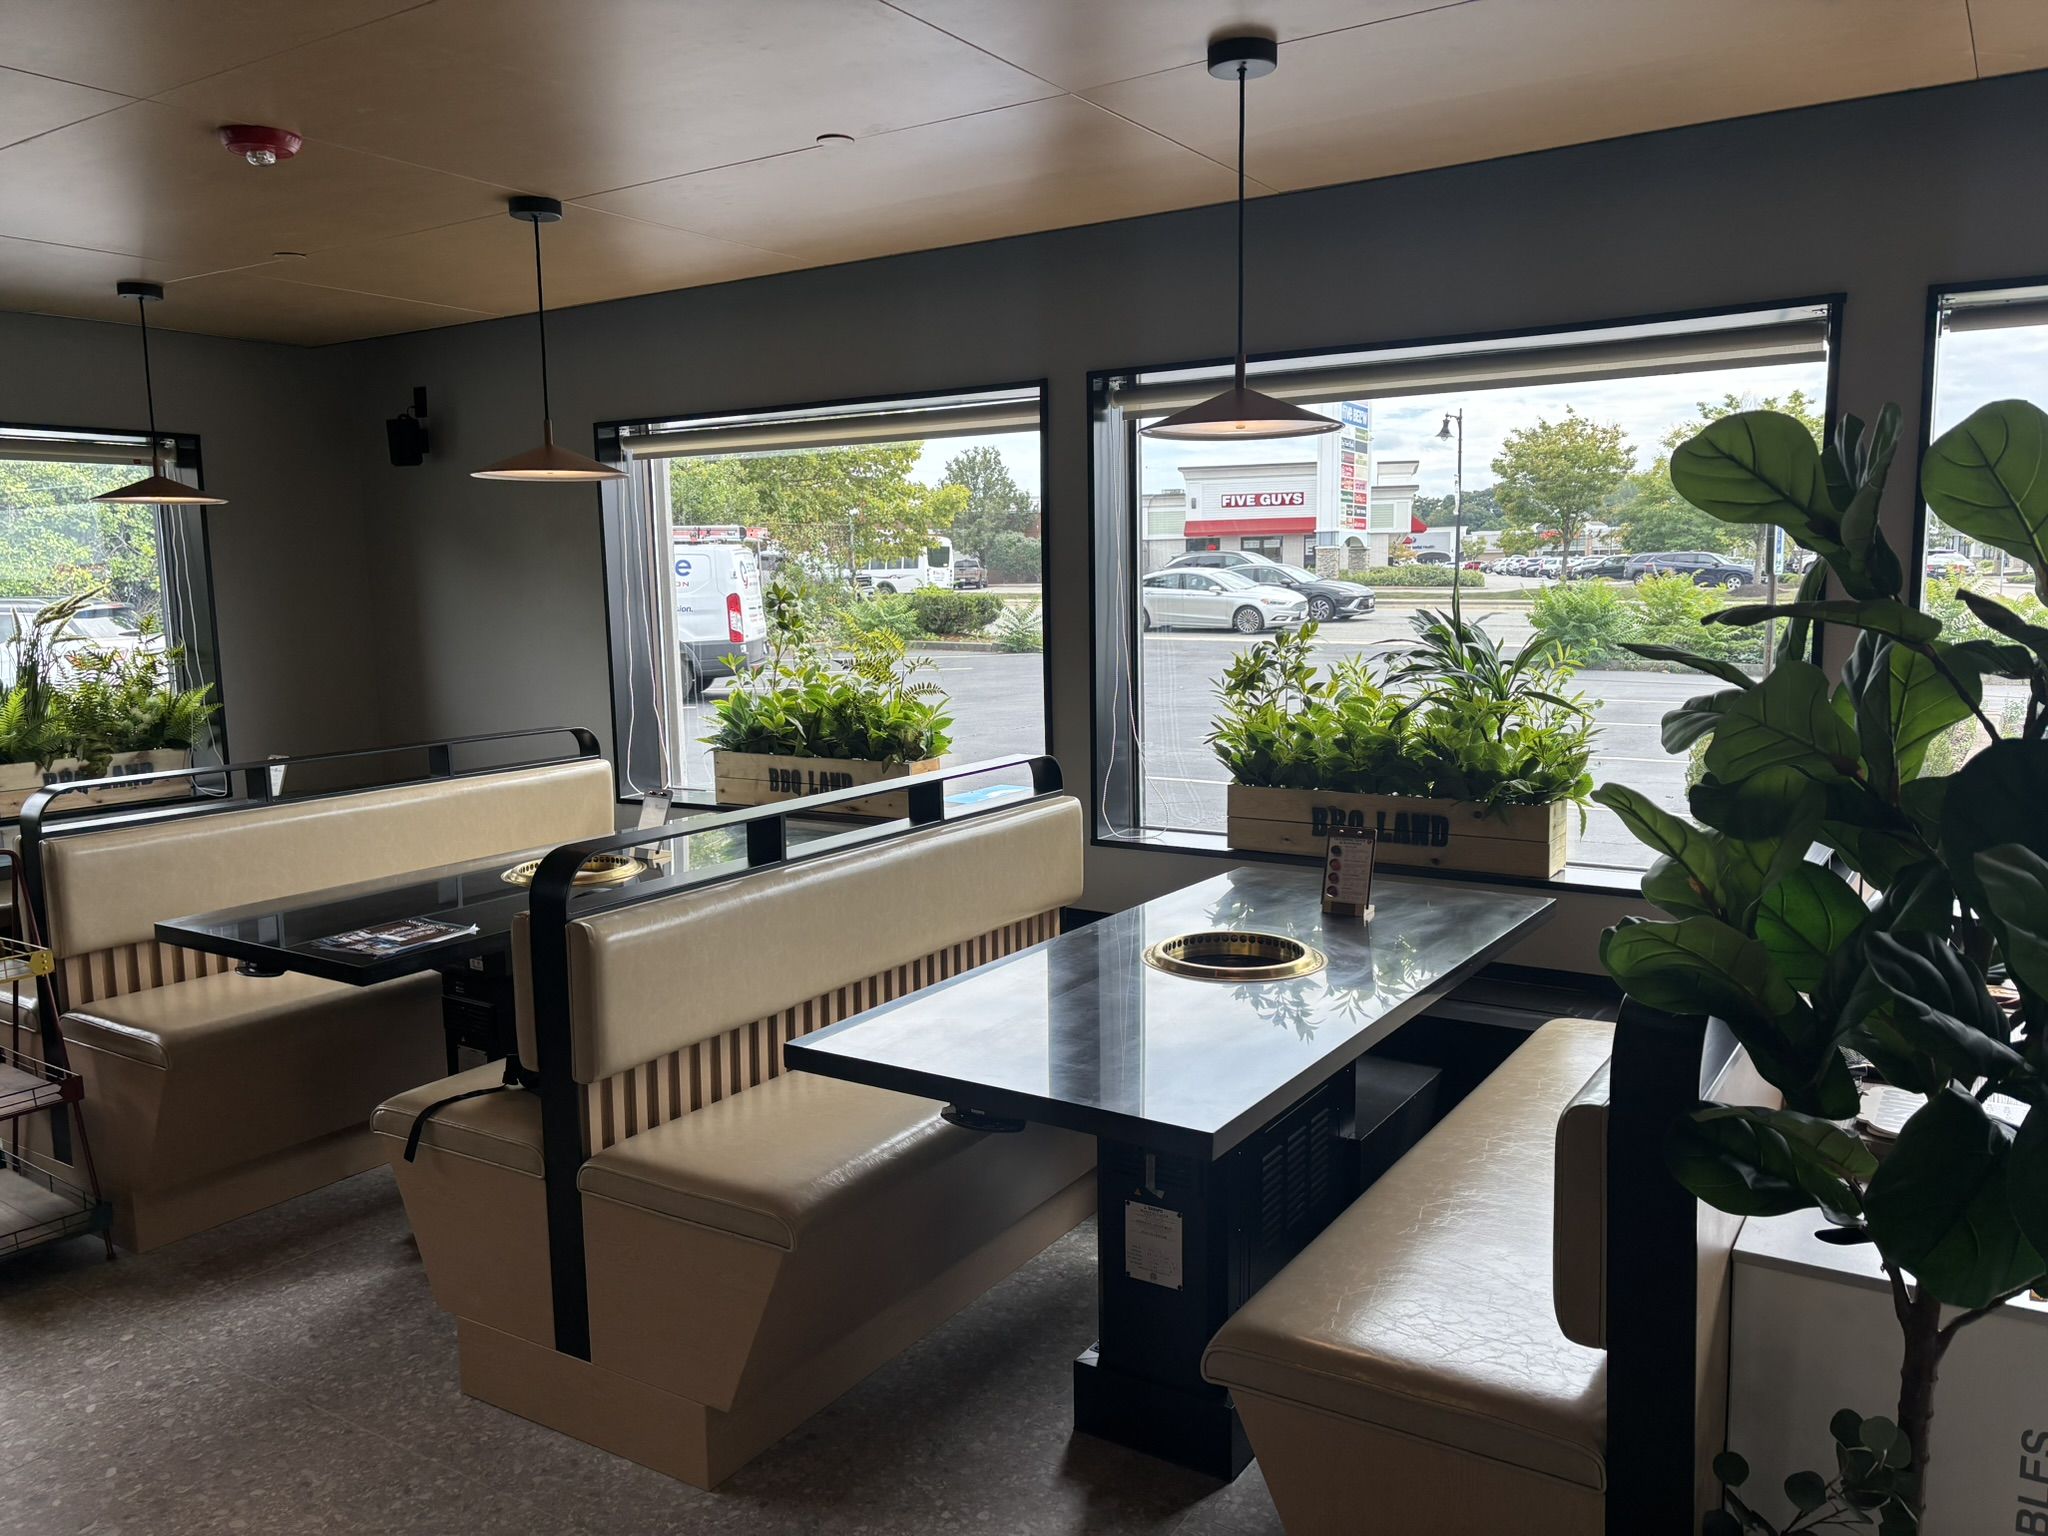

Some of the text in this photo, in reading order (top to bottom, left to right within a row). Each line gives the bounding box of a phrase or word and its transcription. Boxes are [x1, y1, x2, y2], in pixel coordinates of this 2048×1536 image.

[1222, 493, 1303, 507] FIVE GUYS
[769, 768, 853, 796] BBQ LAND
[1377, 811, 1449, 848] LAND
